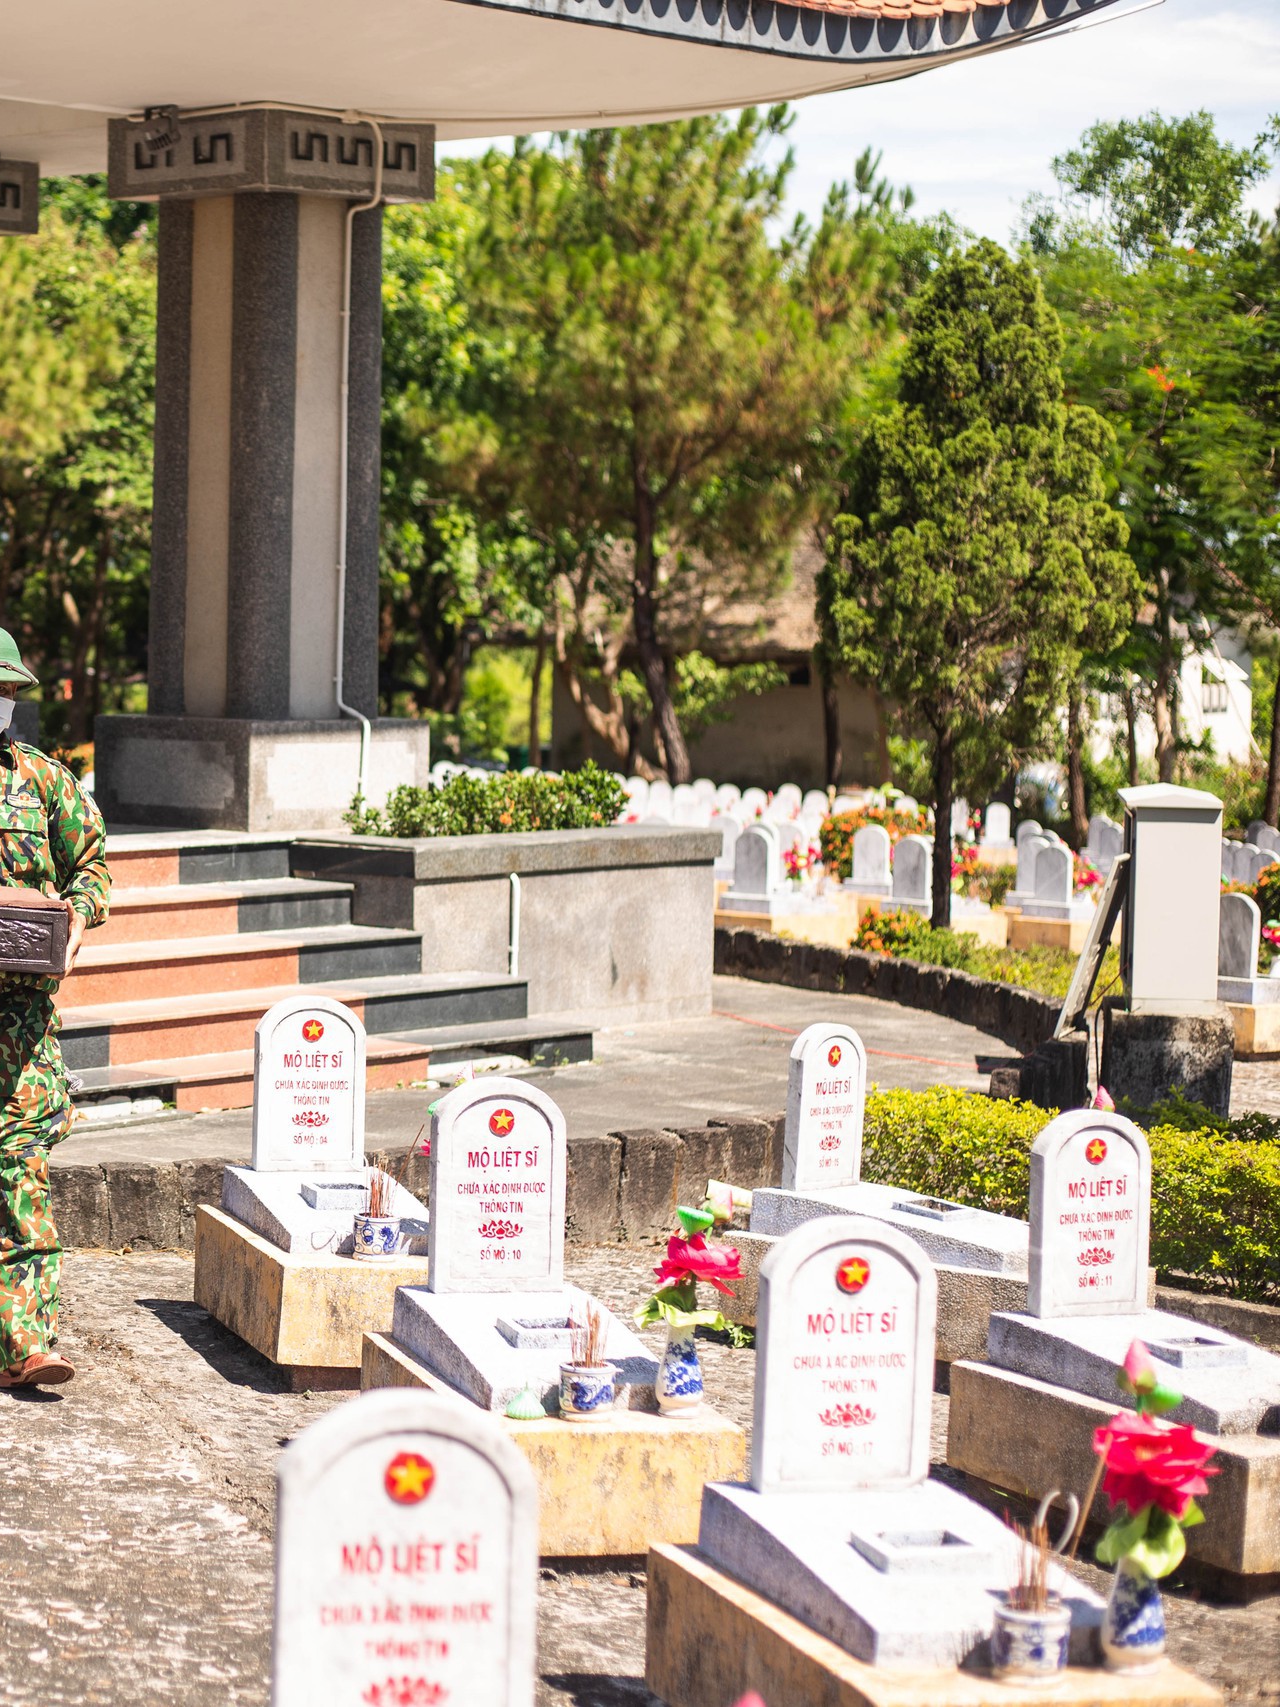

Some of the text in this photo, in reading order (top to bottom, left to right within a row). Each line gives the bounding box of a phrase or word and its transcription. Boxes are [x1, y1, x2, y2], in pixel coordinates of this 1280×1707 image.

[284, 1050, 343, 1072] MỘ LIỆT SĨ
[275, 1078, 348, 1092] CHƯA XÁC ĐỊNH ĐƯỢC
[816, 1078, 827, 1099] MỘ
[829, 1077, 842, 1098] LIỆT
[293, 1093, 330, 1105] THÔNG TIN
[293, 1132, 303, 1144] SỐ
[304, 1133, 314, 1148] MỘ
[468, 1146, 539, 1173] MỘ LIỆT SĨ
[458, 1180, 546, 1197] CHƯA XÁC ĐỊNH ĐƯỢC
[1069, 1175, 1127, 1203] MỘ LIỆT SĨ
[480, 1199, 523, 1213] THÔNG TIN
[1060, 1210, 1133, 1225] CHƯA XÁC ĐỊNH ĐƯỢC
[1079, 1228, 1115, 1241] THÔNG TIN
[480, 1245, 491, 1260] SỐ
[494, 1246, 505, 1264] MỘ
[513, 1250, 521, 1259] 10
[1079, 1272, 1087, 1287] SỐ
[1089, 1273, 1099, 1289] MỘ
[1105, 1275, 1112, 1285] 11
[808, 1306, 898, 1342] MỘ LIỆT SĨ
[861, 1379, 877, 1392] TIN
[341, 1536, 383, 1586] MỘ
[392, 1536, 444, 1585] LIỆT
